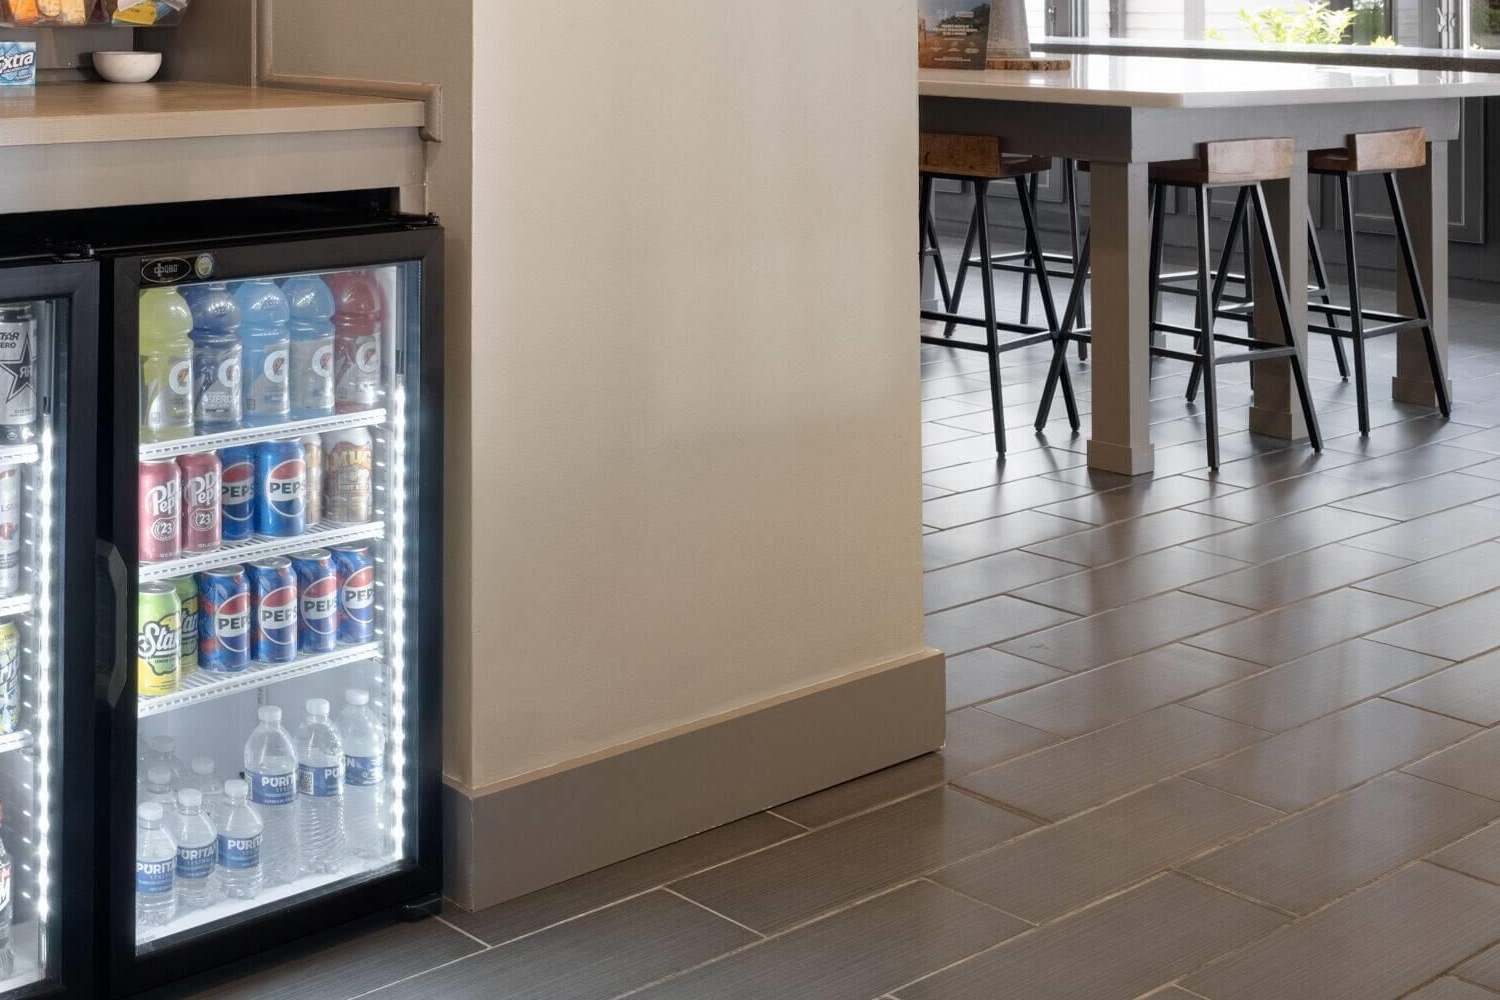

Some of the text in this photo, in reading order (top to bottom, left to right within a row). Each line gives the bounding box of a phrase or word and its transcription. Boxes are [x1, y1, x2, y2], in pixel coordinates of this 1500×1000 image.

[222, 485, 254, 498] PEPS
[270, 481, 306, 494] PEPS
[199, 513, 211, 522] 23
[160, 522, 173, 533] 23
[304, 599, 337, 612] PEPS
[261, 609, 297, 622] PEPS
[218, 616, 251, 630] PEPS
